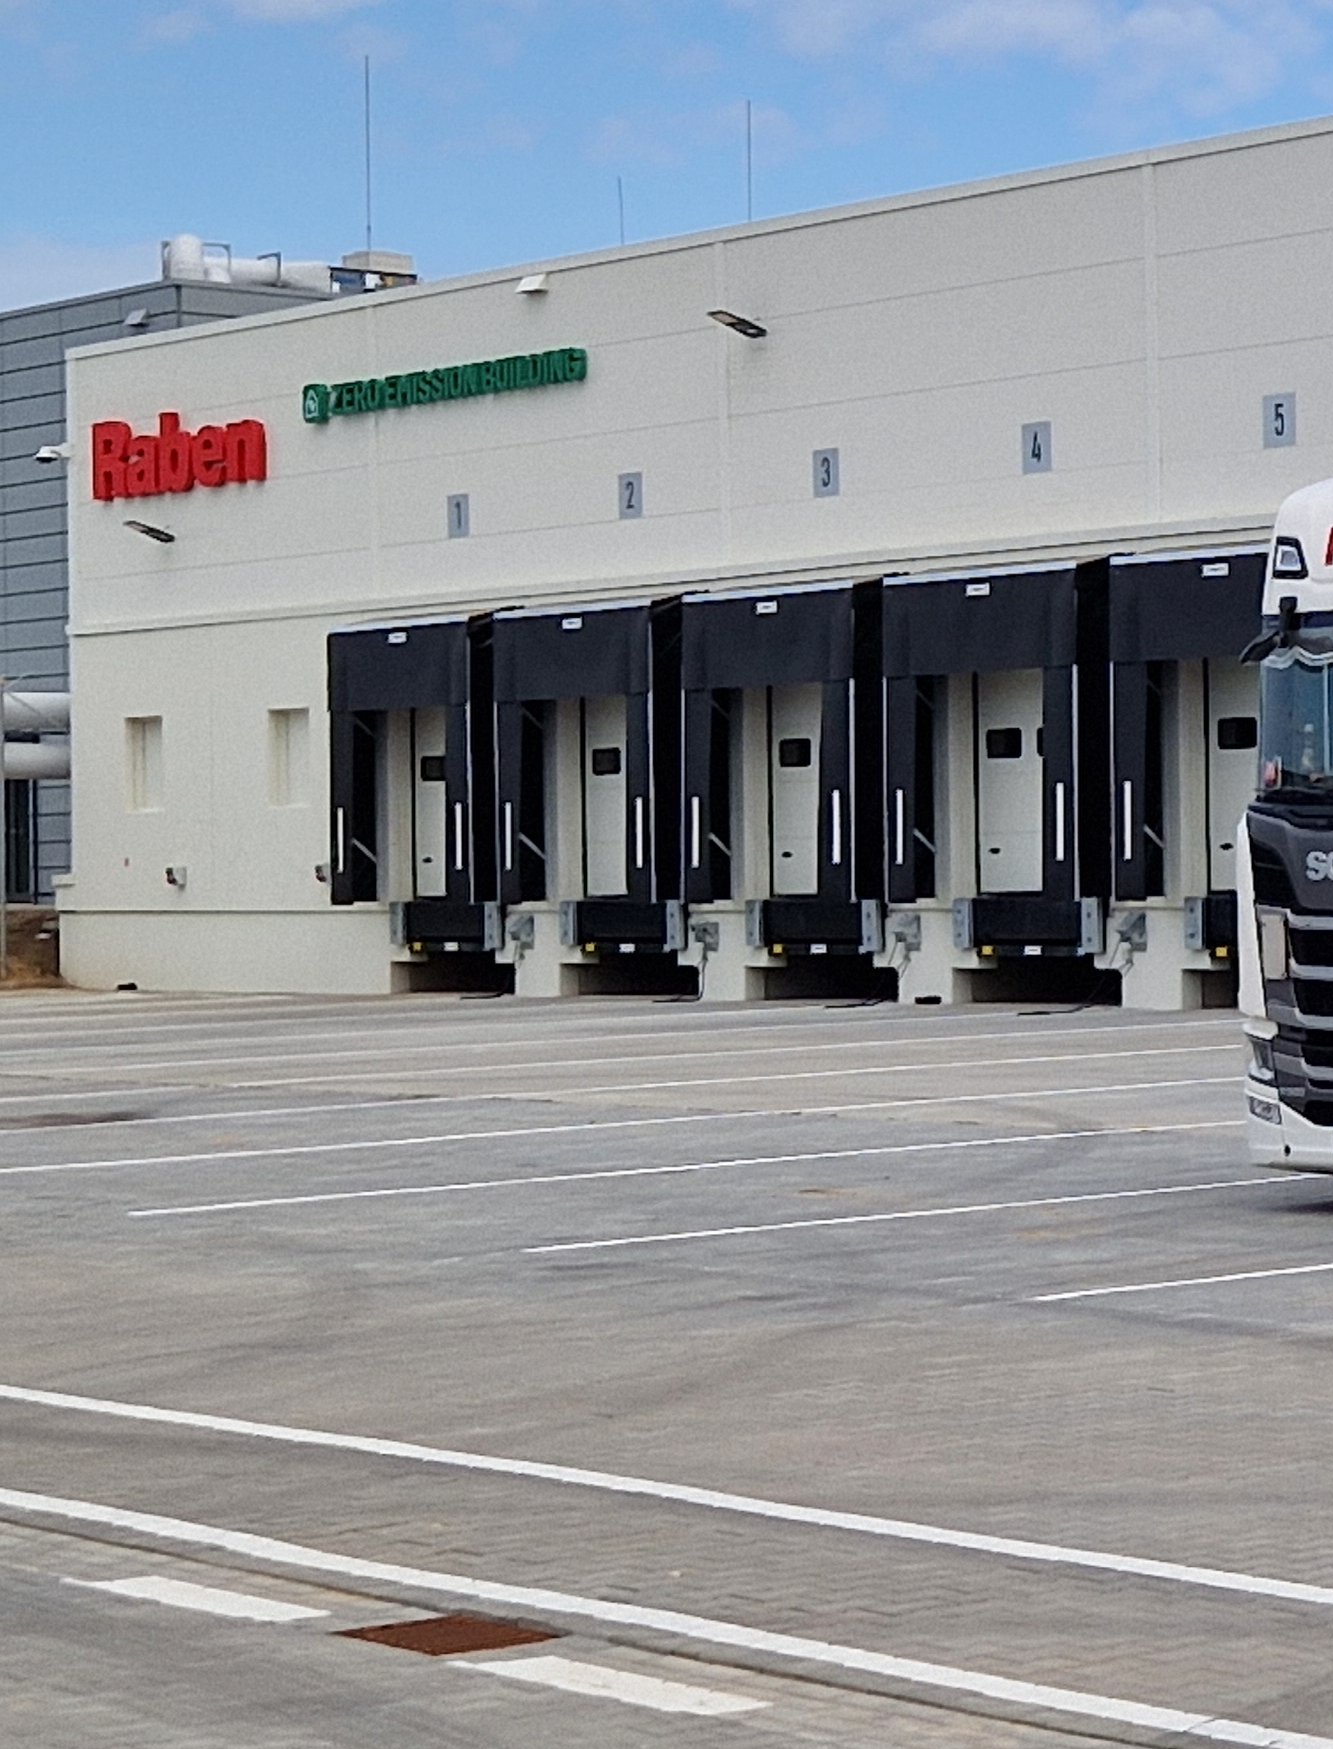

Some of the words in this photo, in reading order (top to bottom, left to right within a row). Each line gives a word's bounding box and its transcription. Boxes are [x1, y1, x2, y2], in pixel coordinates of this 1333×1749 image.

[331, 379, 380, 416] ZERO
[384, 363, 478, 407] EMISSION
[482, 347, 588, 394] BUILDING
[1274, 402, 1285, 437] 5
[91, 411, 268, 502] Raben
[1031, 431, 1042, 463] 4
[820, 456, 832, 488] 3
[624, 480, 636, 510] 2
[453, 501, 463, 529] 1
